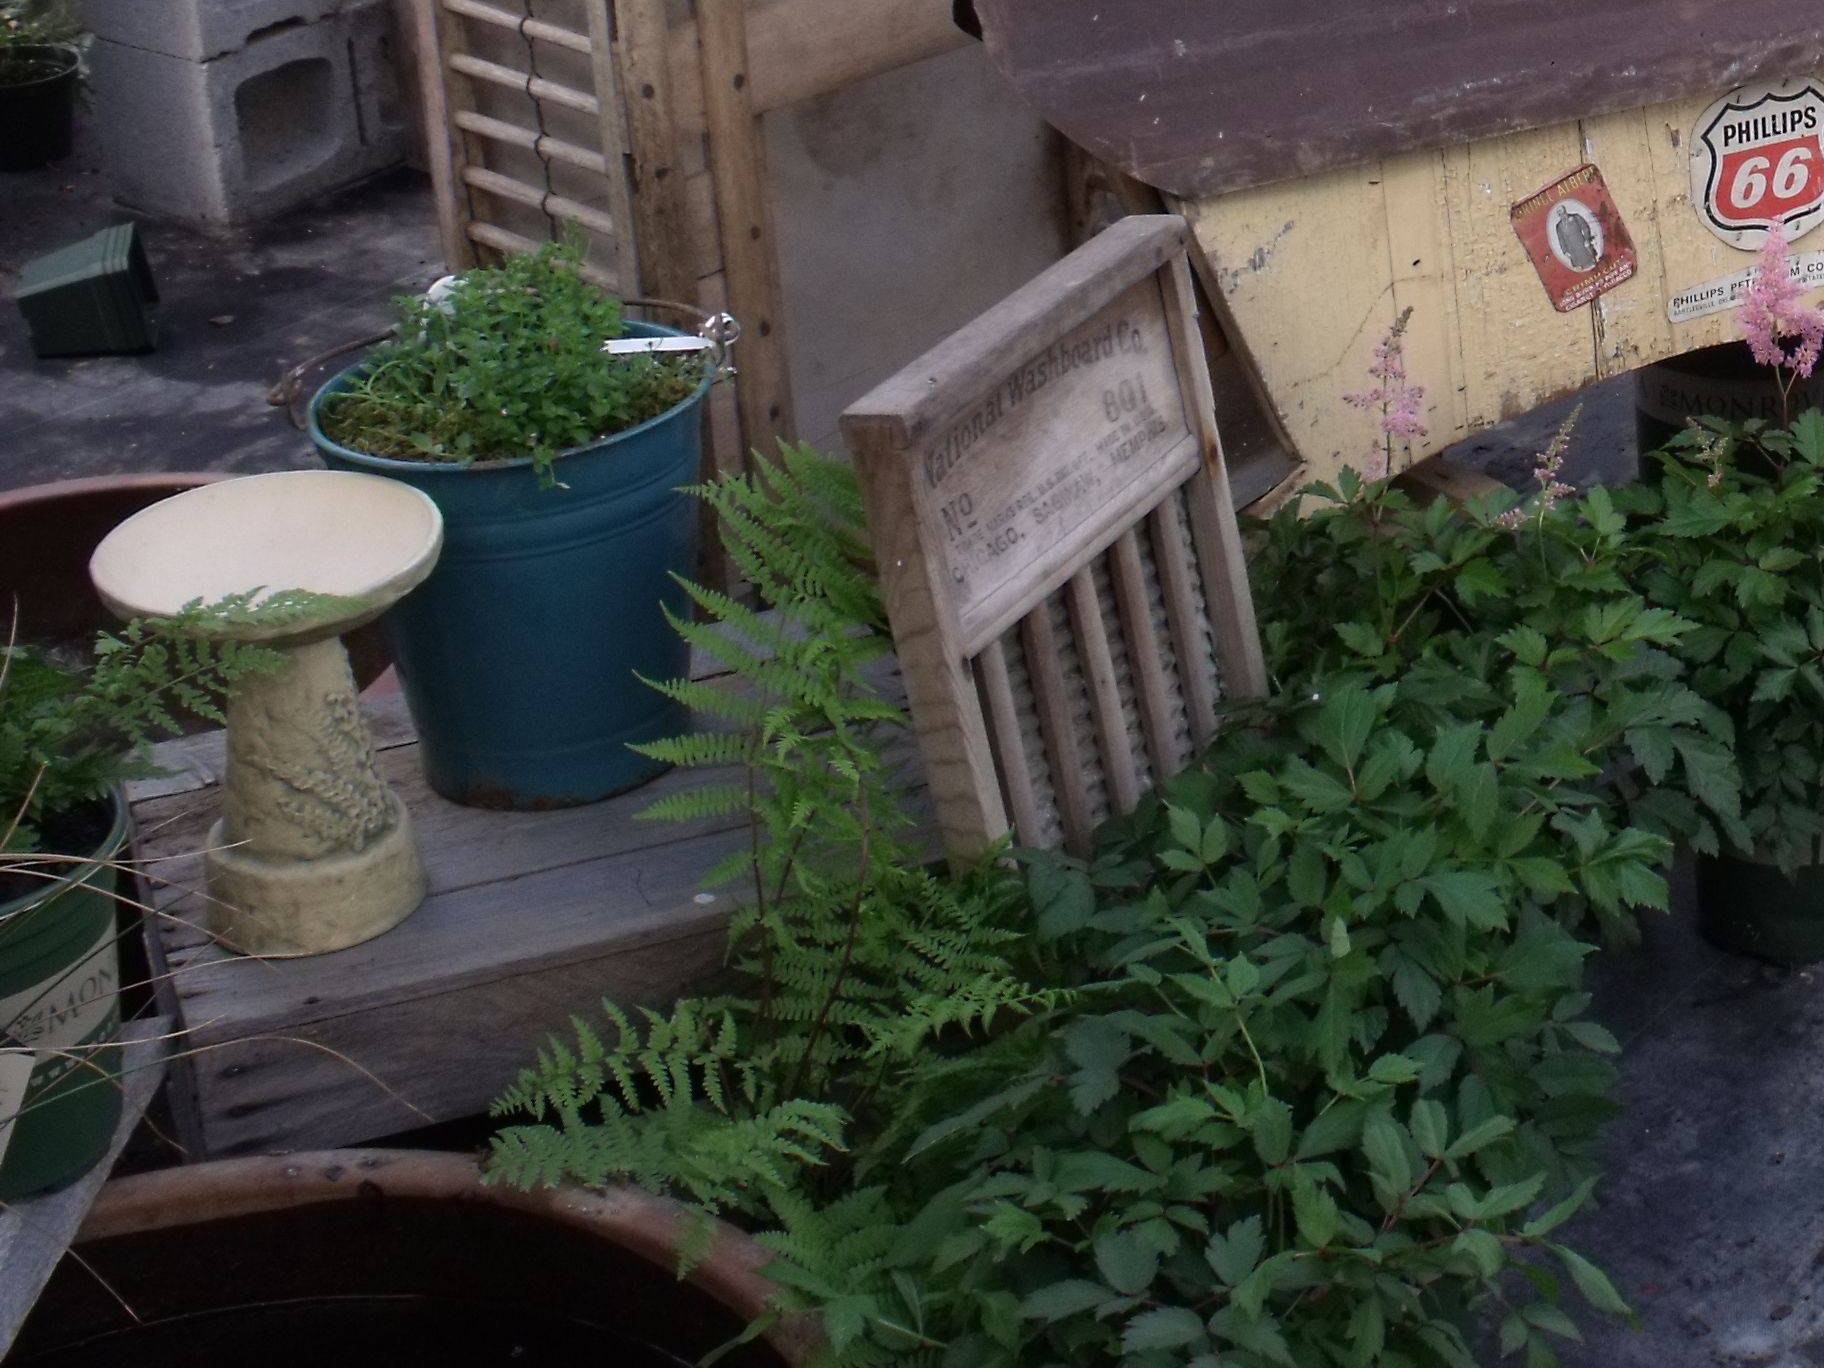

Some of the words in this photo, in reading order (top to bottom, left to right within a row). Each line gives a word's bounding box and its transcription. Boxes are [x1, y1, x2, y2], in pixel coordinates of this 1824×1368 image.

[1722, 105, 1817, 147] PHILLIPS
[1730, 146, 1813, 209] 66
[1672, 287, 1725, 307] PHILLIPS
[924, 394, 1002, 489] National
